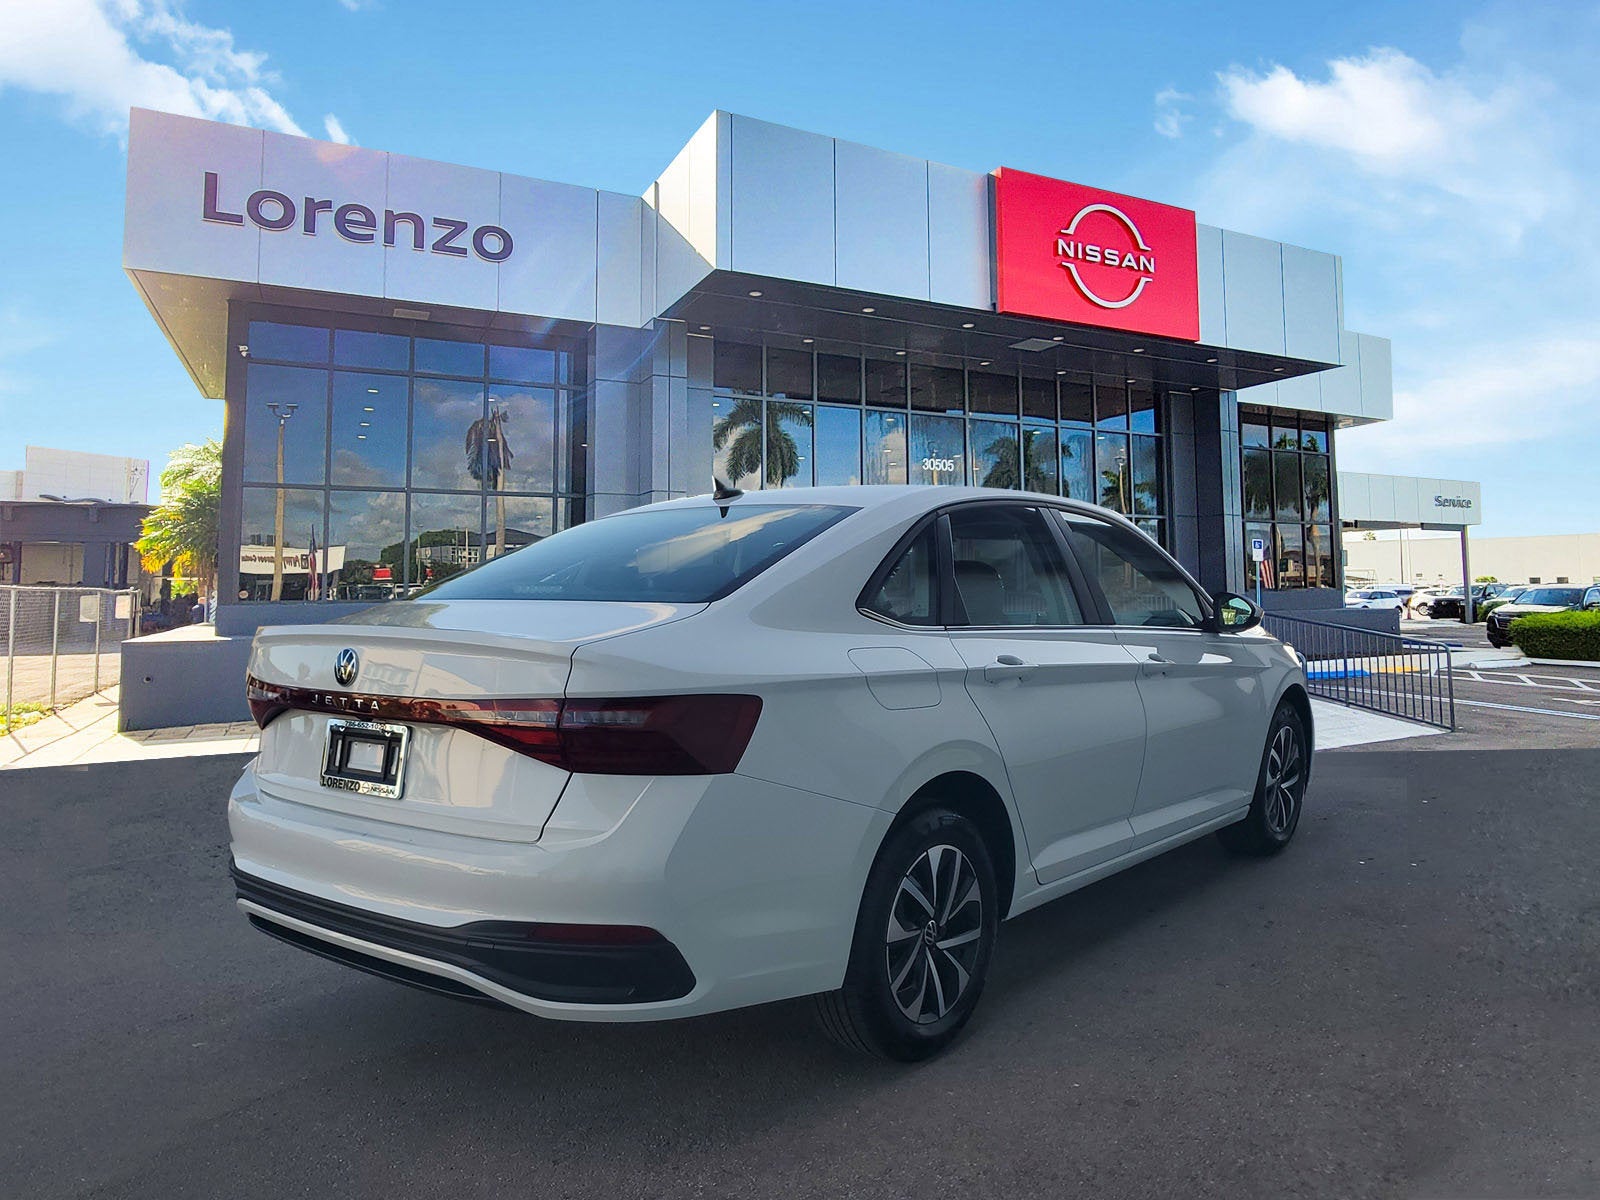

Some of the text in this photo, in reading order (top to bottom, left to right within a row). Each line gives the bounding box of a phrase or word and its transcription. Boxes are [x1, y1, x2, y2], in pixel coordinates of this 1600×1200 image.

[202, 171, 514, 262] Lorenzo
[1057, 238, 1155, 273] NISSAN
[922, 457, 954, 471] 30505
[1434, 495, 1472, 508] Service
[312, 694, 379, 710] JETTA
[321, 776, 395, 795] LORENZO NISSAN
